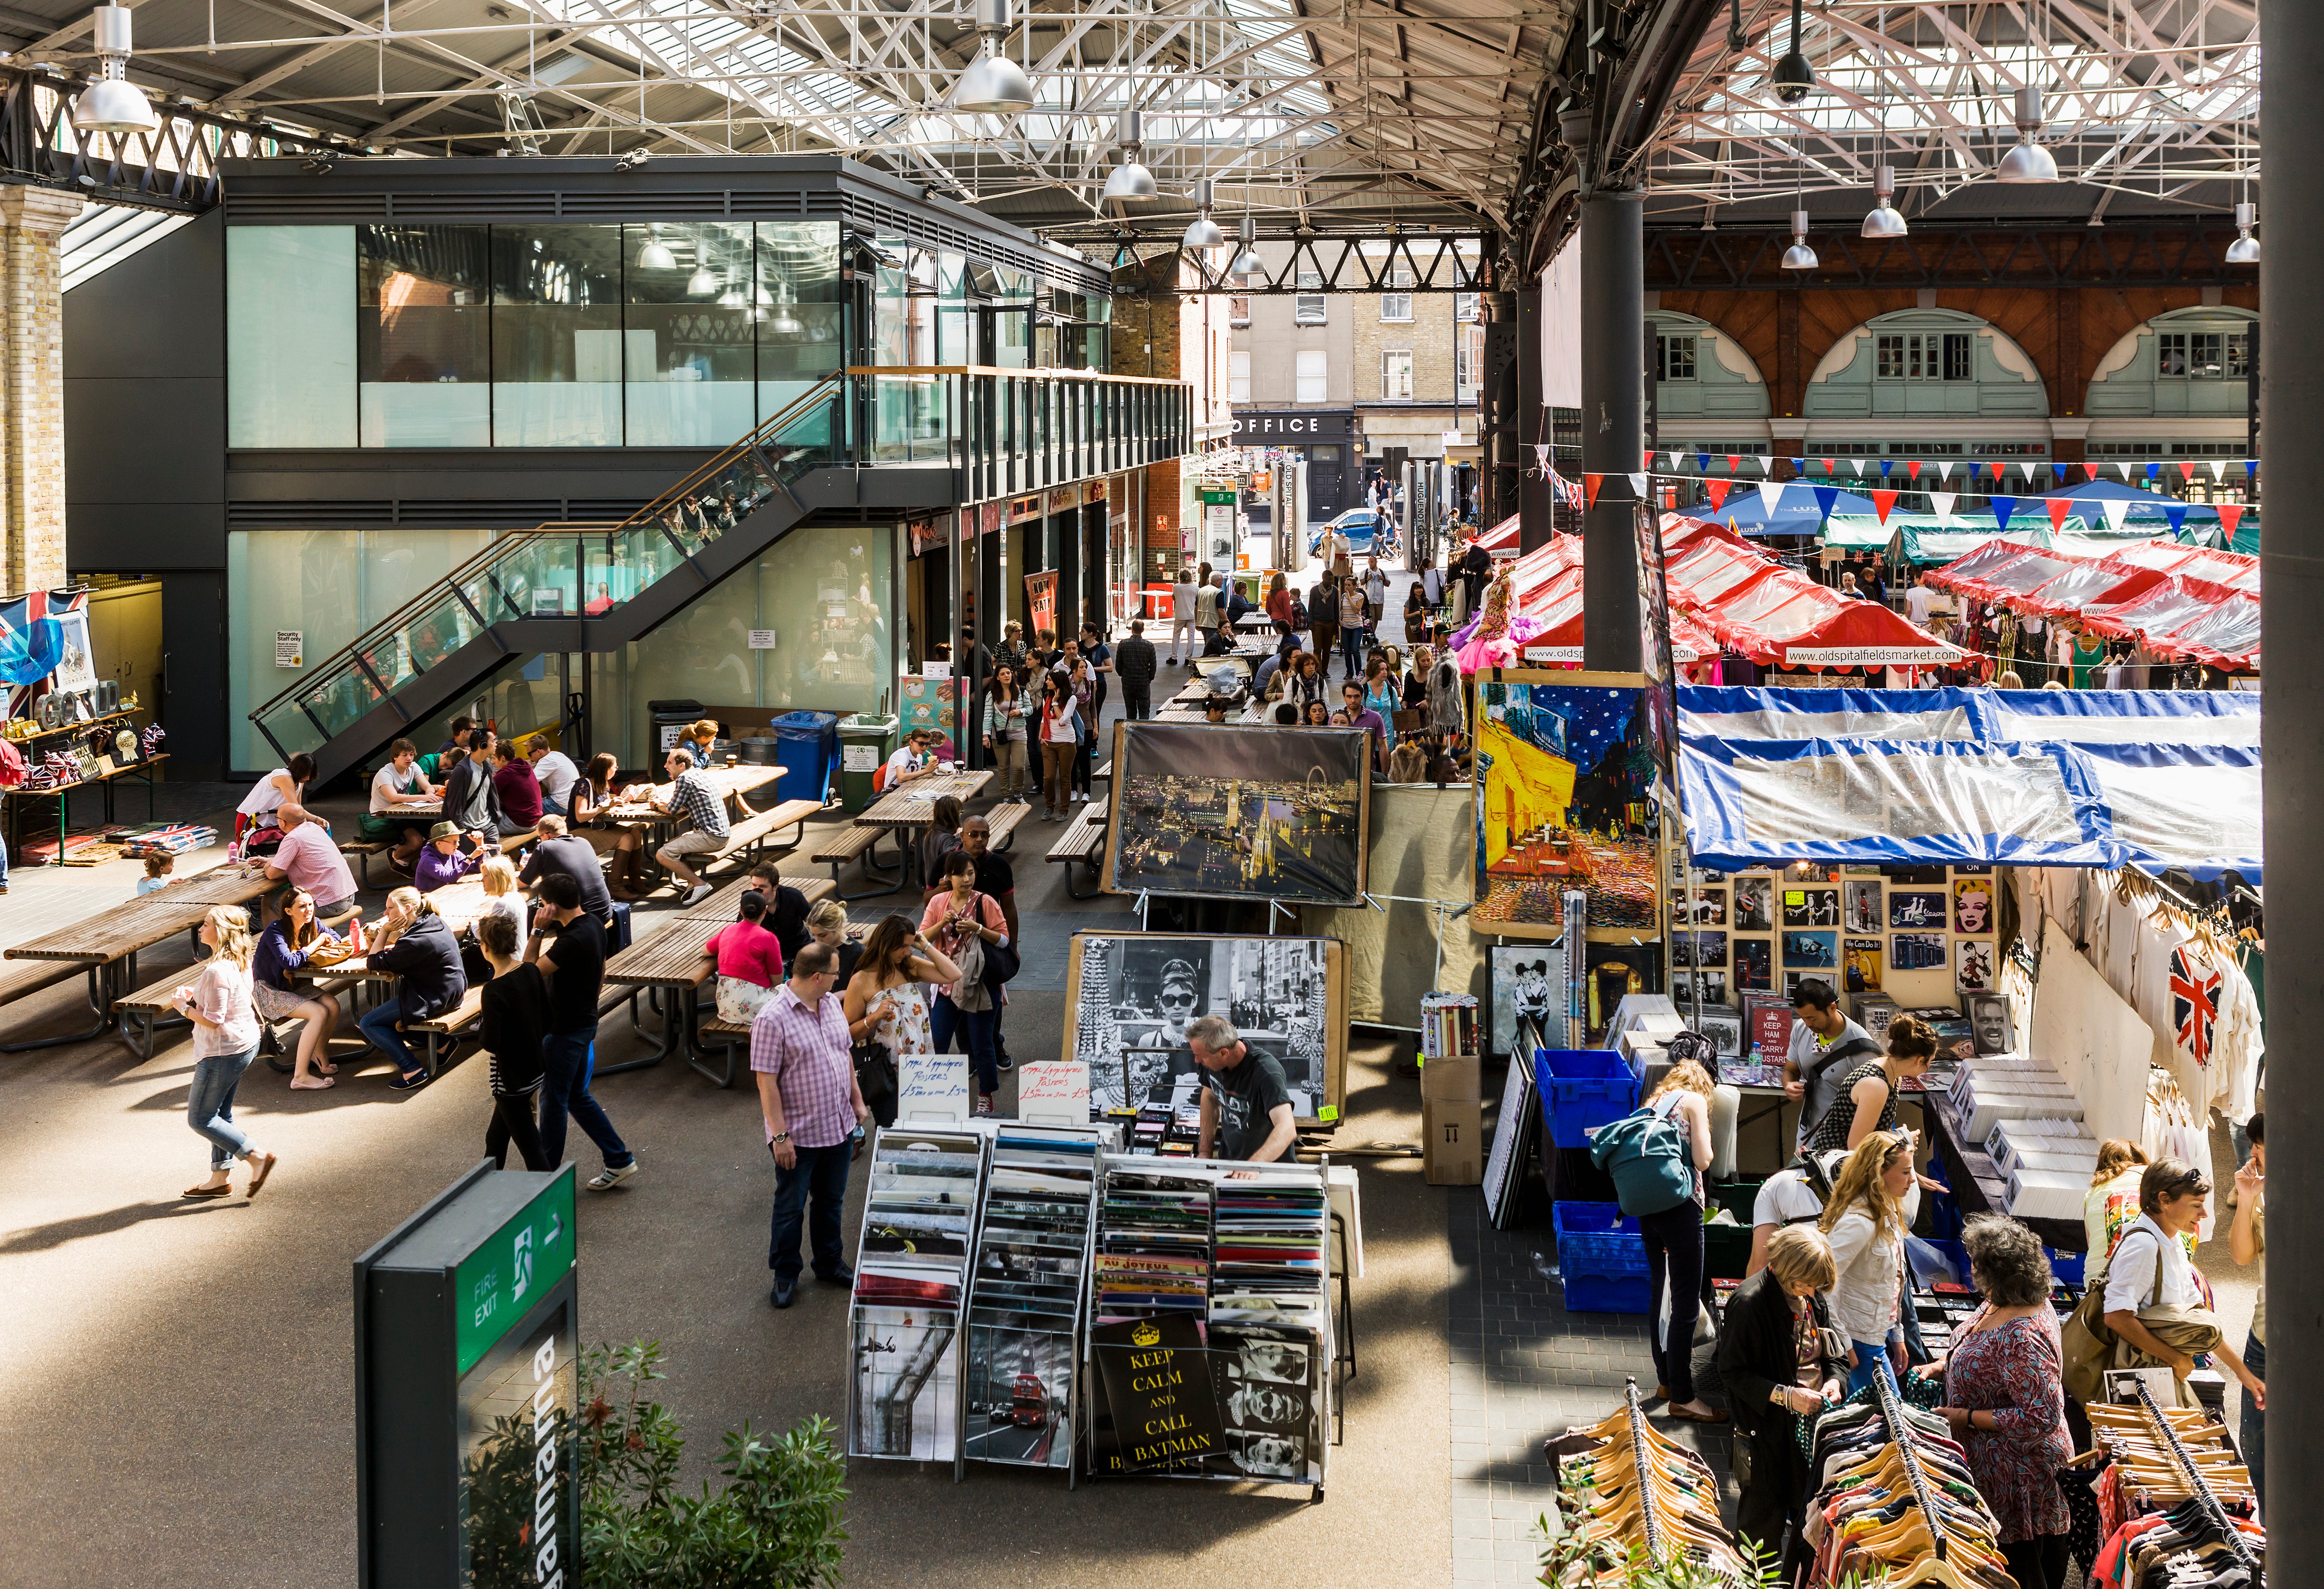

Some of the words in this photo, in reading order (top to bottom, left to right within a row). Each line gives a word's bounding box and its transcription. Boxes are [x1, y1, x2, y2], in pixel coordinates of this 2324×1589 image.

[1232, 418, 1318, 433] OFFICE
[1033, 580, 1049, 594] KOTA
[1789, 649, 1960, 663] www.oldspitalfieldsmarket.com
[65, 676, 87, 684] LONDON
[34, 680, 120, 731] GOLD
[72, 744, 90, 758] STAY
[1923, 908, 1946, 917] Vespa
[475, 1267, 497, 1302] FIRE
[475, 1293, 497, 1327] EXIT
[1130, 1349, 1174, 1369] KEEP
[1133, 1370, 1183, 1392] CALM
[1150, 1394, 1176, 1409] AND
[1145, 1414, 1192, 1435] CALL
[1135, 1433, 1211, 1462] BATMAN
